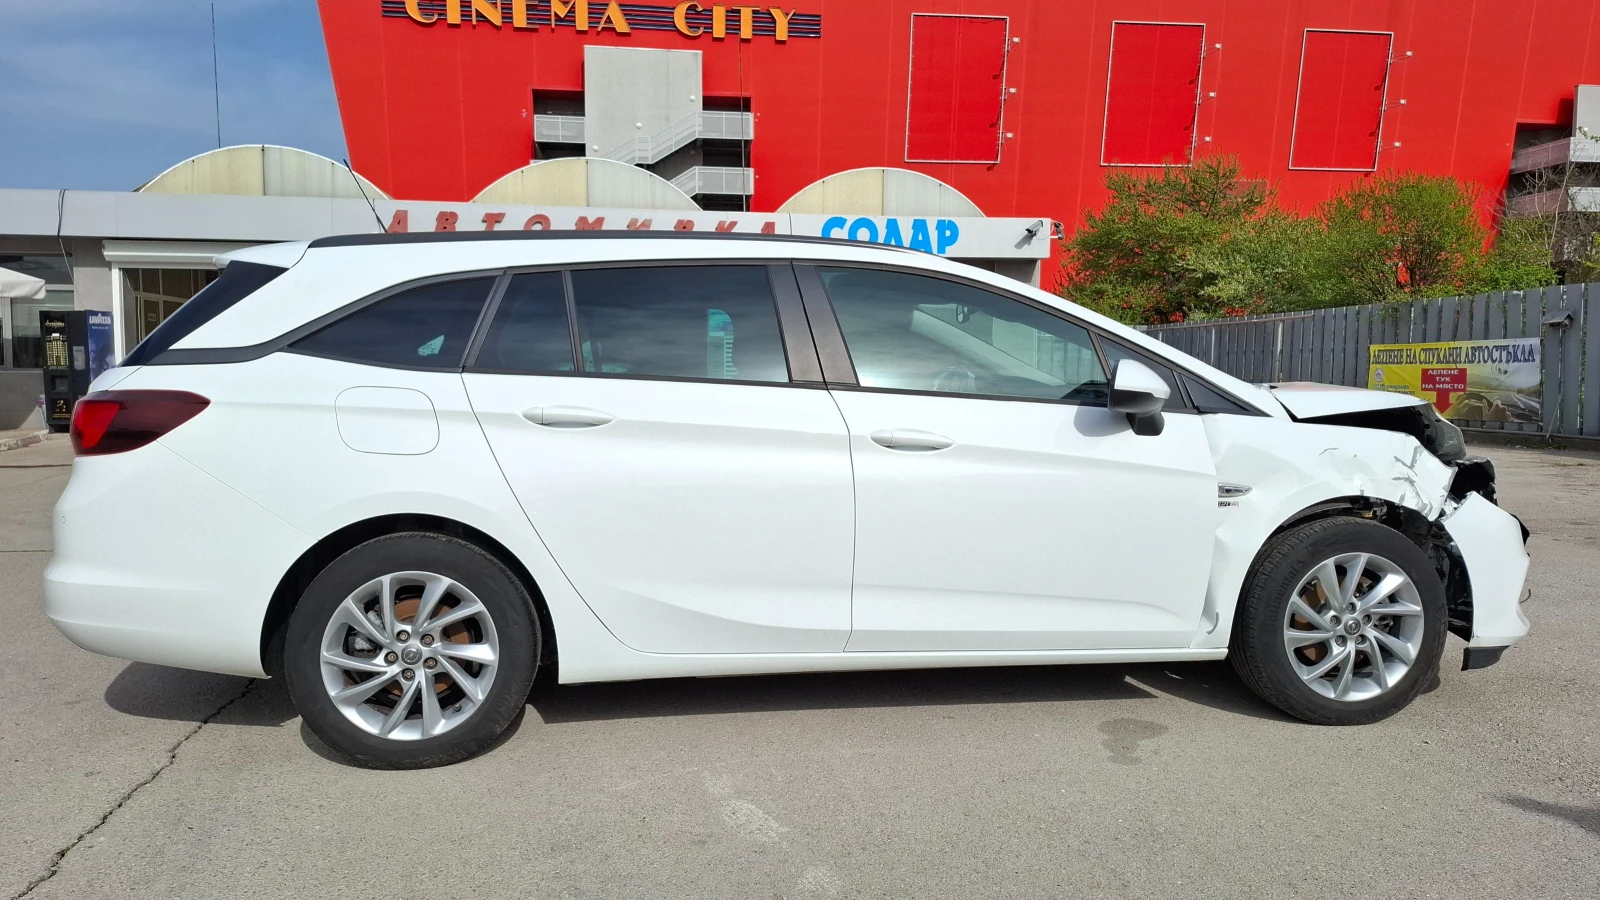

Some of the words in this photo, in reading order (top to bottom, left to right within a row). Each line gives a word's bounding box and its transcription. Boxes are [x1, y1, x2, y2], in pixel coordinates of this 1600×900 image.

[405, 0, 631, 33] CINEMA
[674, 1, 796, 41] CITY
[1371, 348, 1404, 364] ЛЕПЕНЕ
[1405, 348, 1417, 364] НА
[1419, 347, 1462, 365] СПУКАНИ
[1463, 344, 1535, 364] АВТОСТЪКЛА
